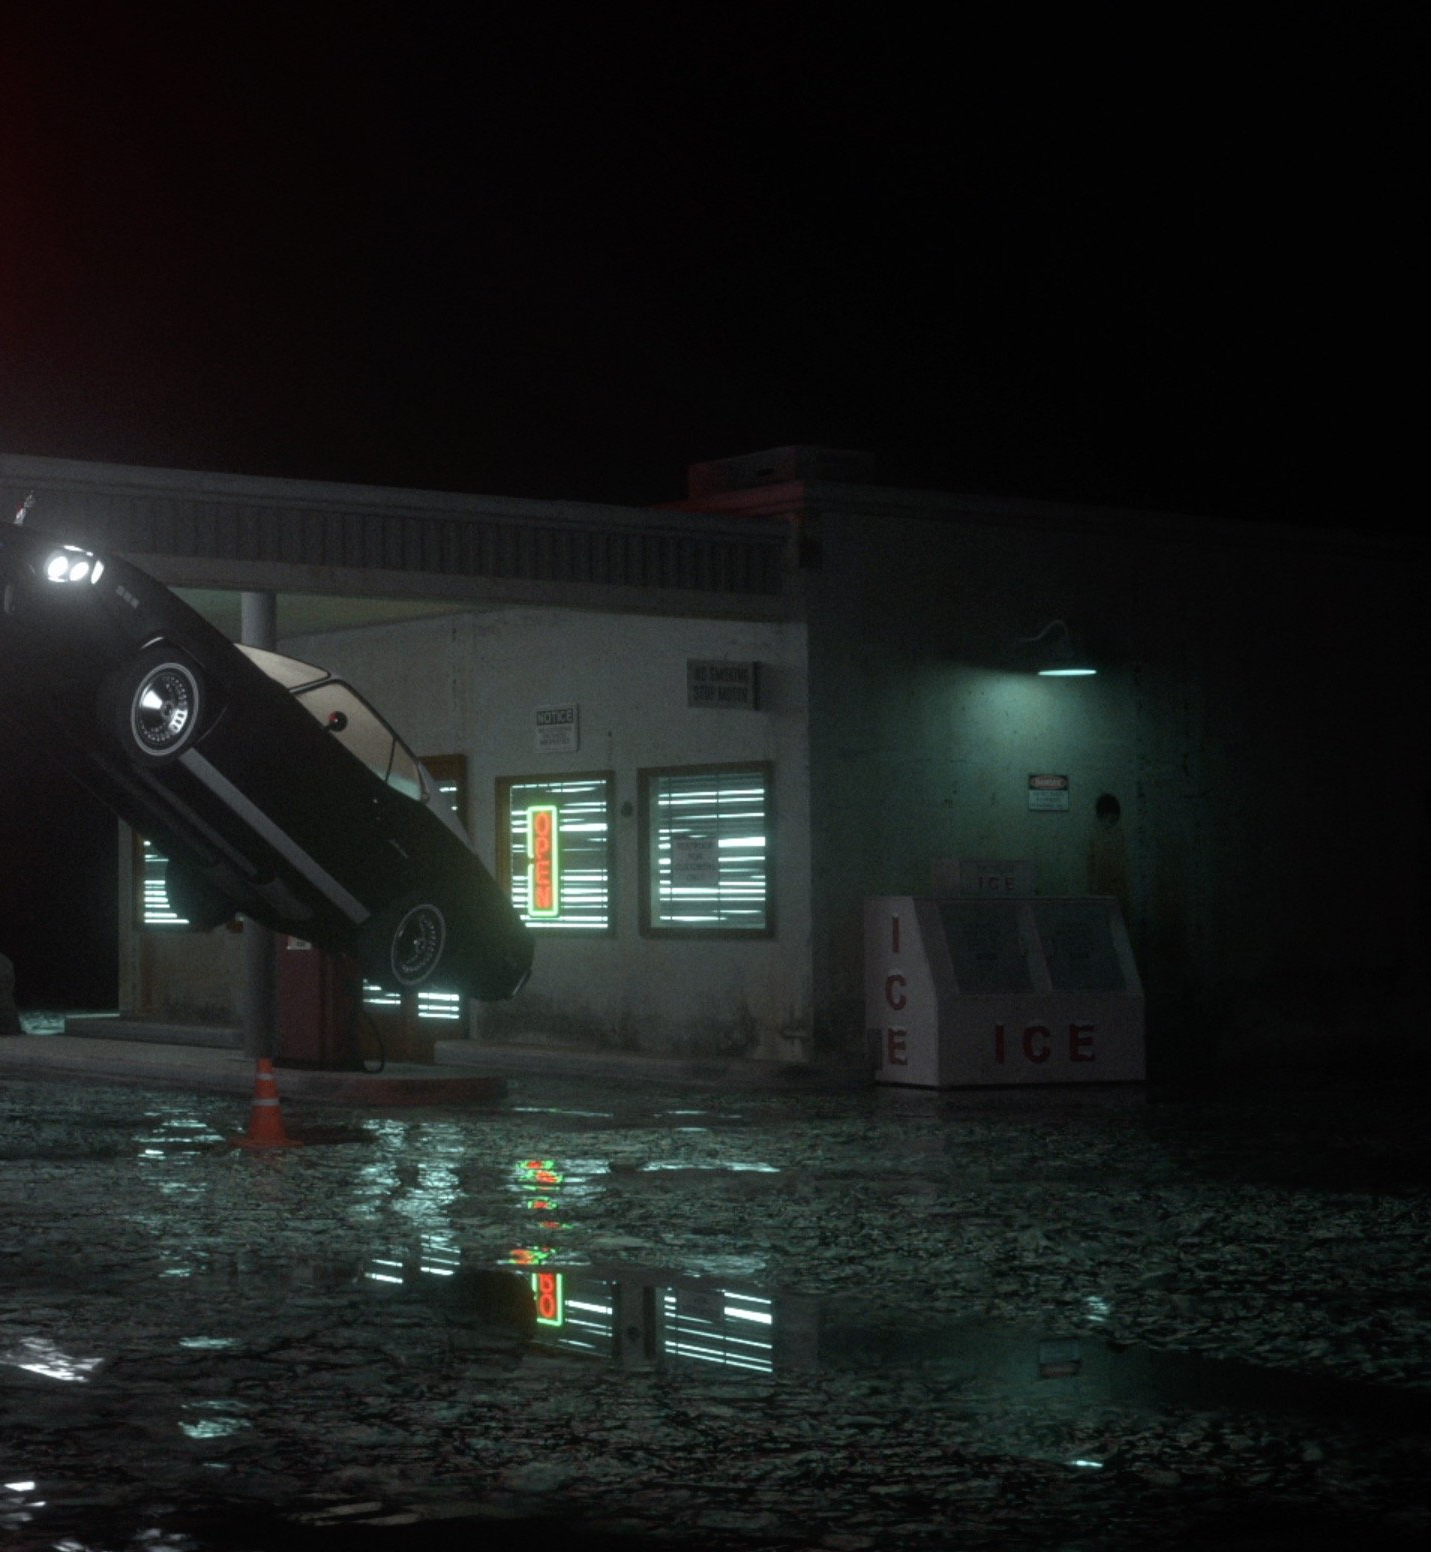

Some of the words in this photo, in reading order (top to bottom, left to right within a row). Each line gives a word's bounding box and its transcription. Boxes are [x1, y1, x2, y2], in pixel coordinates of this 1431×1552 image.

[537, 708, 573, 724] NOTICE
[534, 811, 551, 909] OPEN
[978, 876, 1016, 891] ICE
[884, 916, 908, 1066] ICE
[994, 1023, 1096, 1065] ICE
